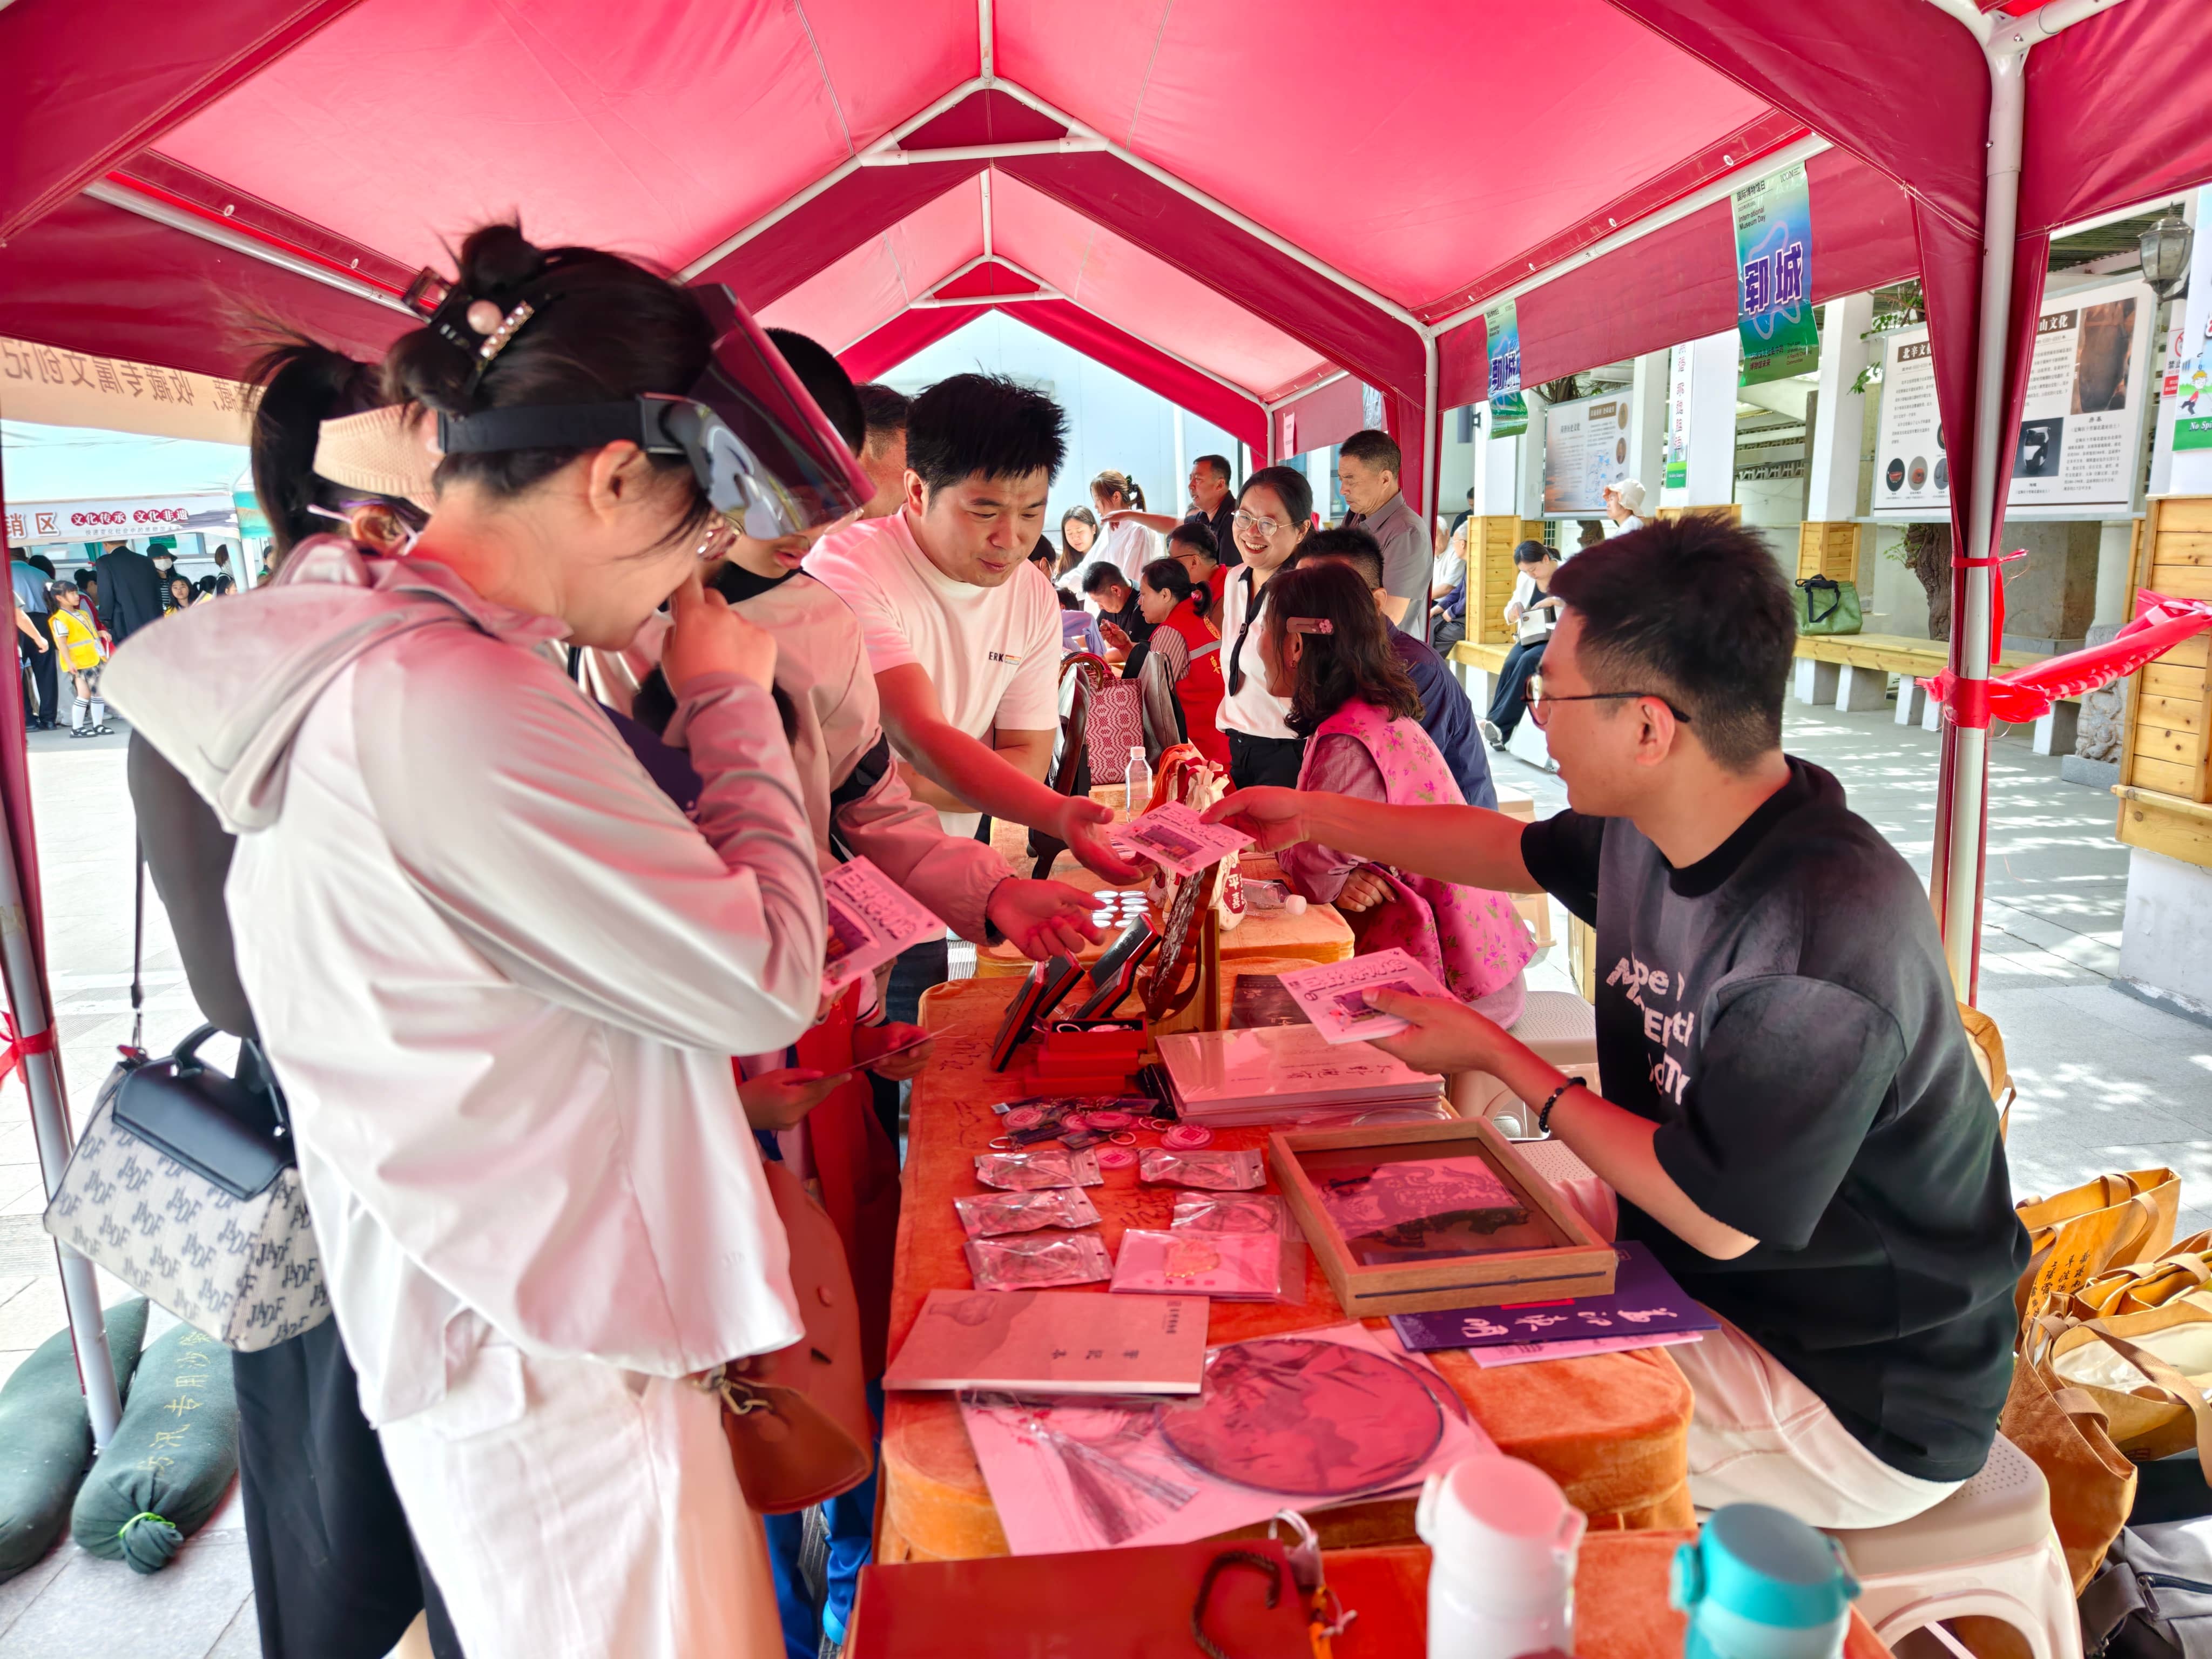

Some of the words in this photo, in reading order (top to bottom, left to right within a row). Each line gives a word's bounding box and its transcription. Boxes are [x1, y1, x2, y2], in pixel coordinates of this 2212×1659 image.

[1737, 180, 1765, 201] 国际博物馆日
[1739, 206, 1765, 222] International
[1739, 218, 1757, 230] Museum
[1758, 215, 1766, 223] Day
[1744, 241, 1803, 315] 郓城
[2038, 314, 2068, 332] 山文化
[2189, 422, 2200, 431] No
[72, 511, 126, 526] 文化传承
[133, 508, 189, 523] 文化非遗
[989, 651, 1004, 662] ERK
